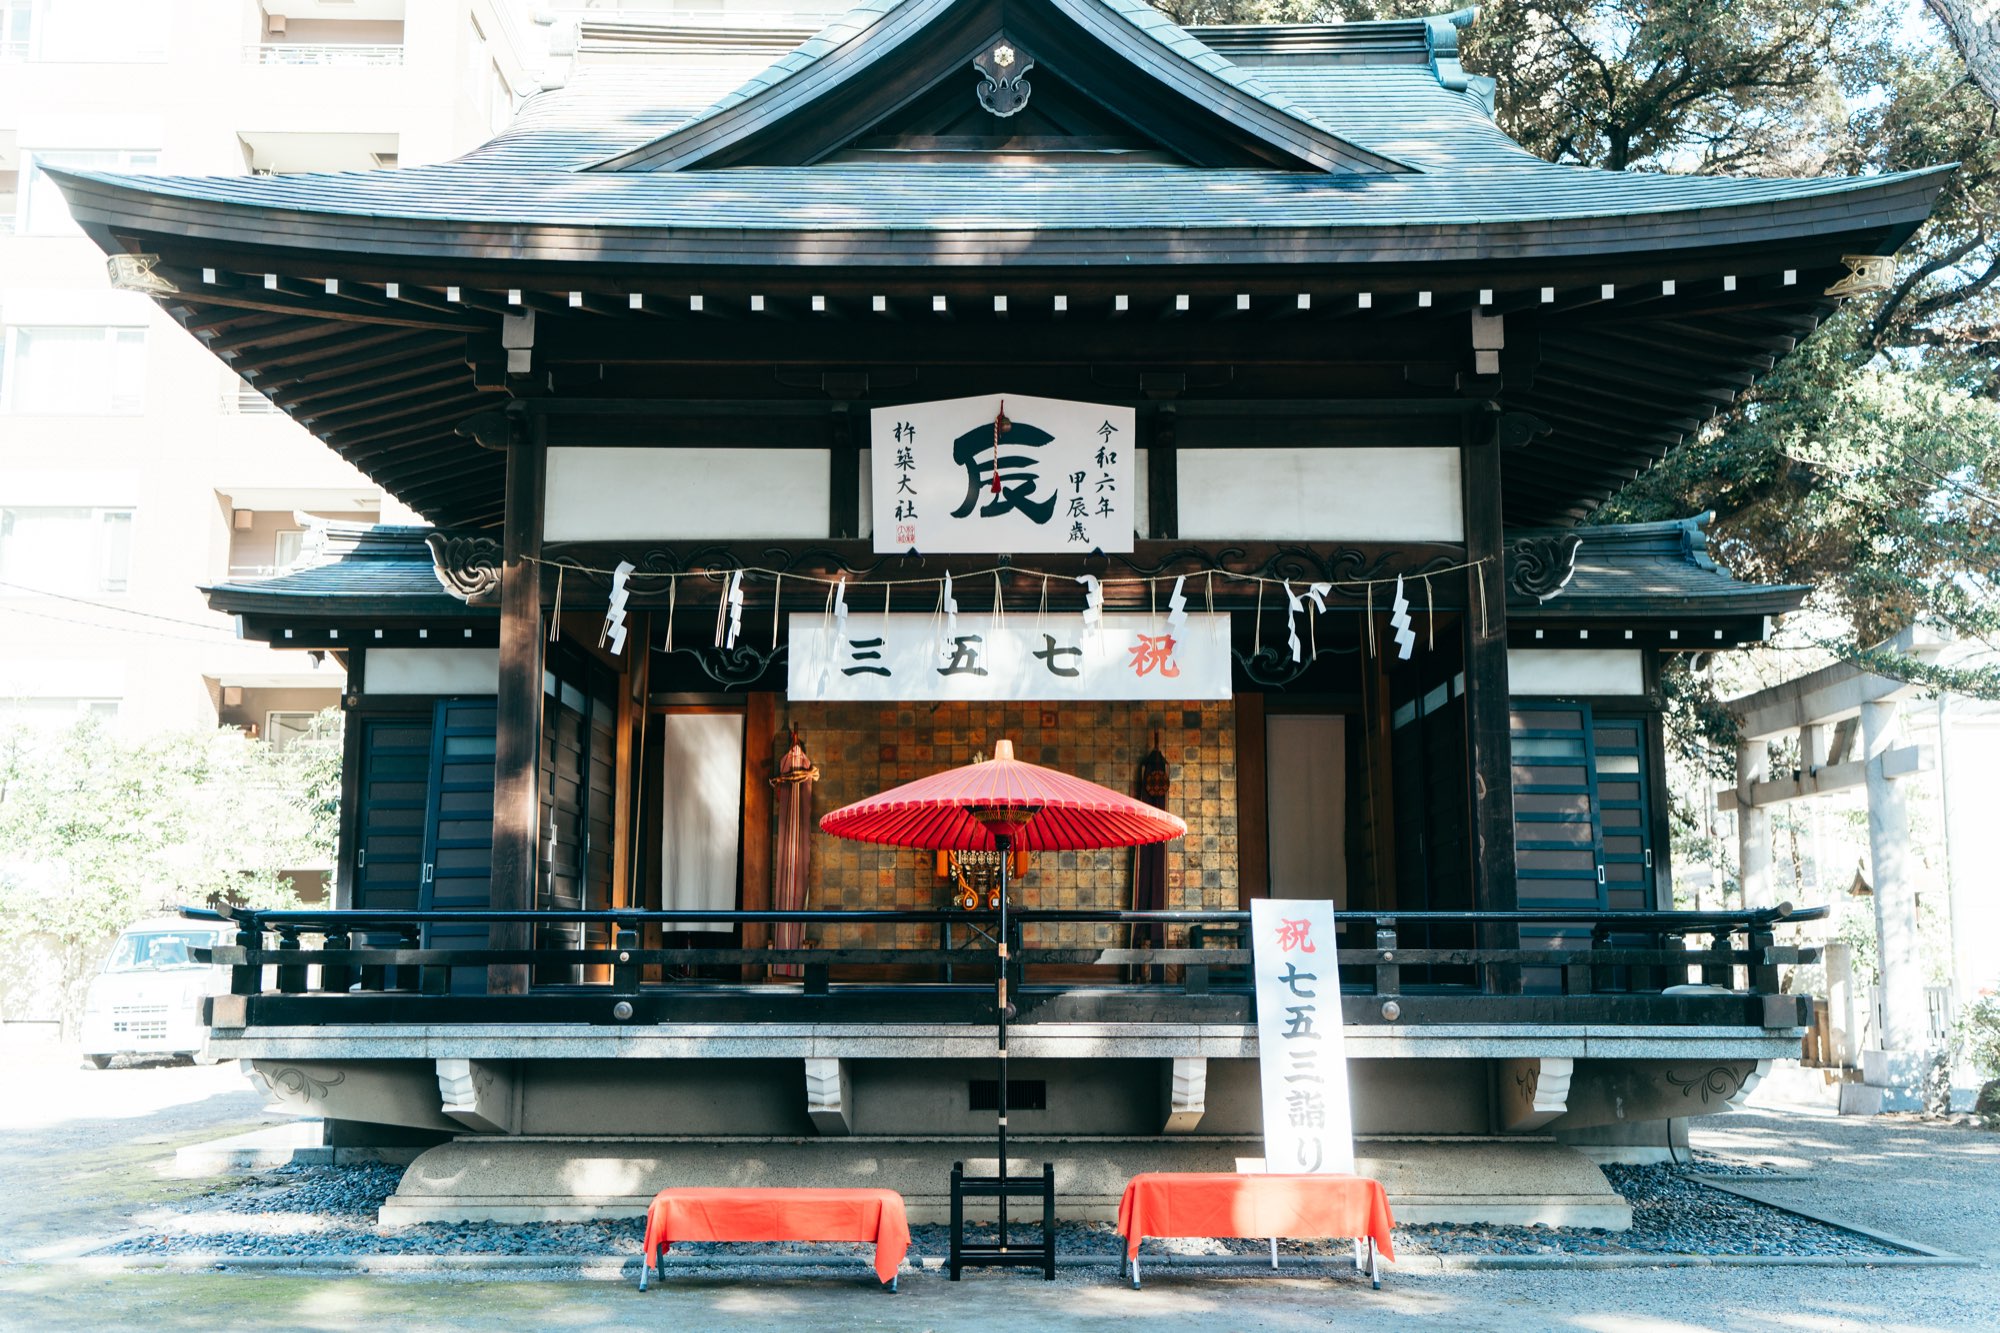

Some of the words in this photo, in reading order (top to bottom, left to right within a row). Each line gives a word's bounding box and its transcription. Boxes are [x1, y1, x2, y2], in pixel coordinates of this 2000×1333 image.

[893, 421, 918, 522] 杵築大社
[950, 421, 1058, 525] 辰
[1094, 420, 1119, 519] 令和六年
